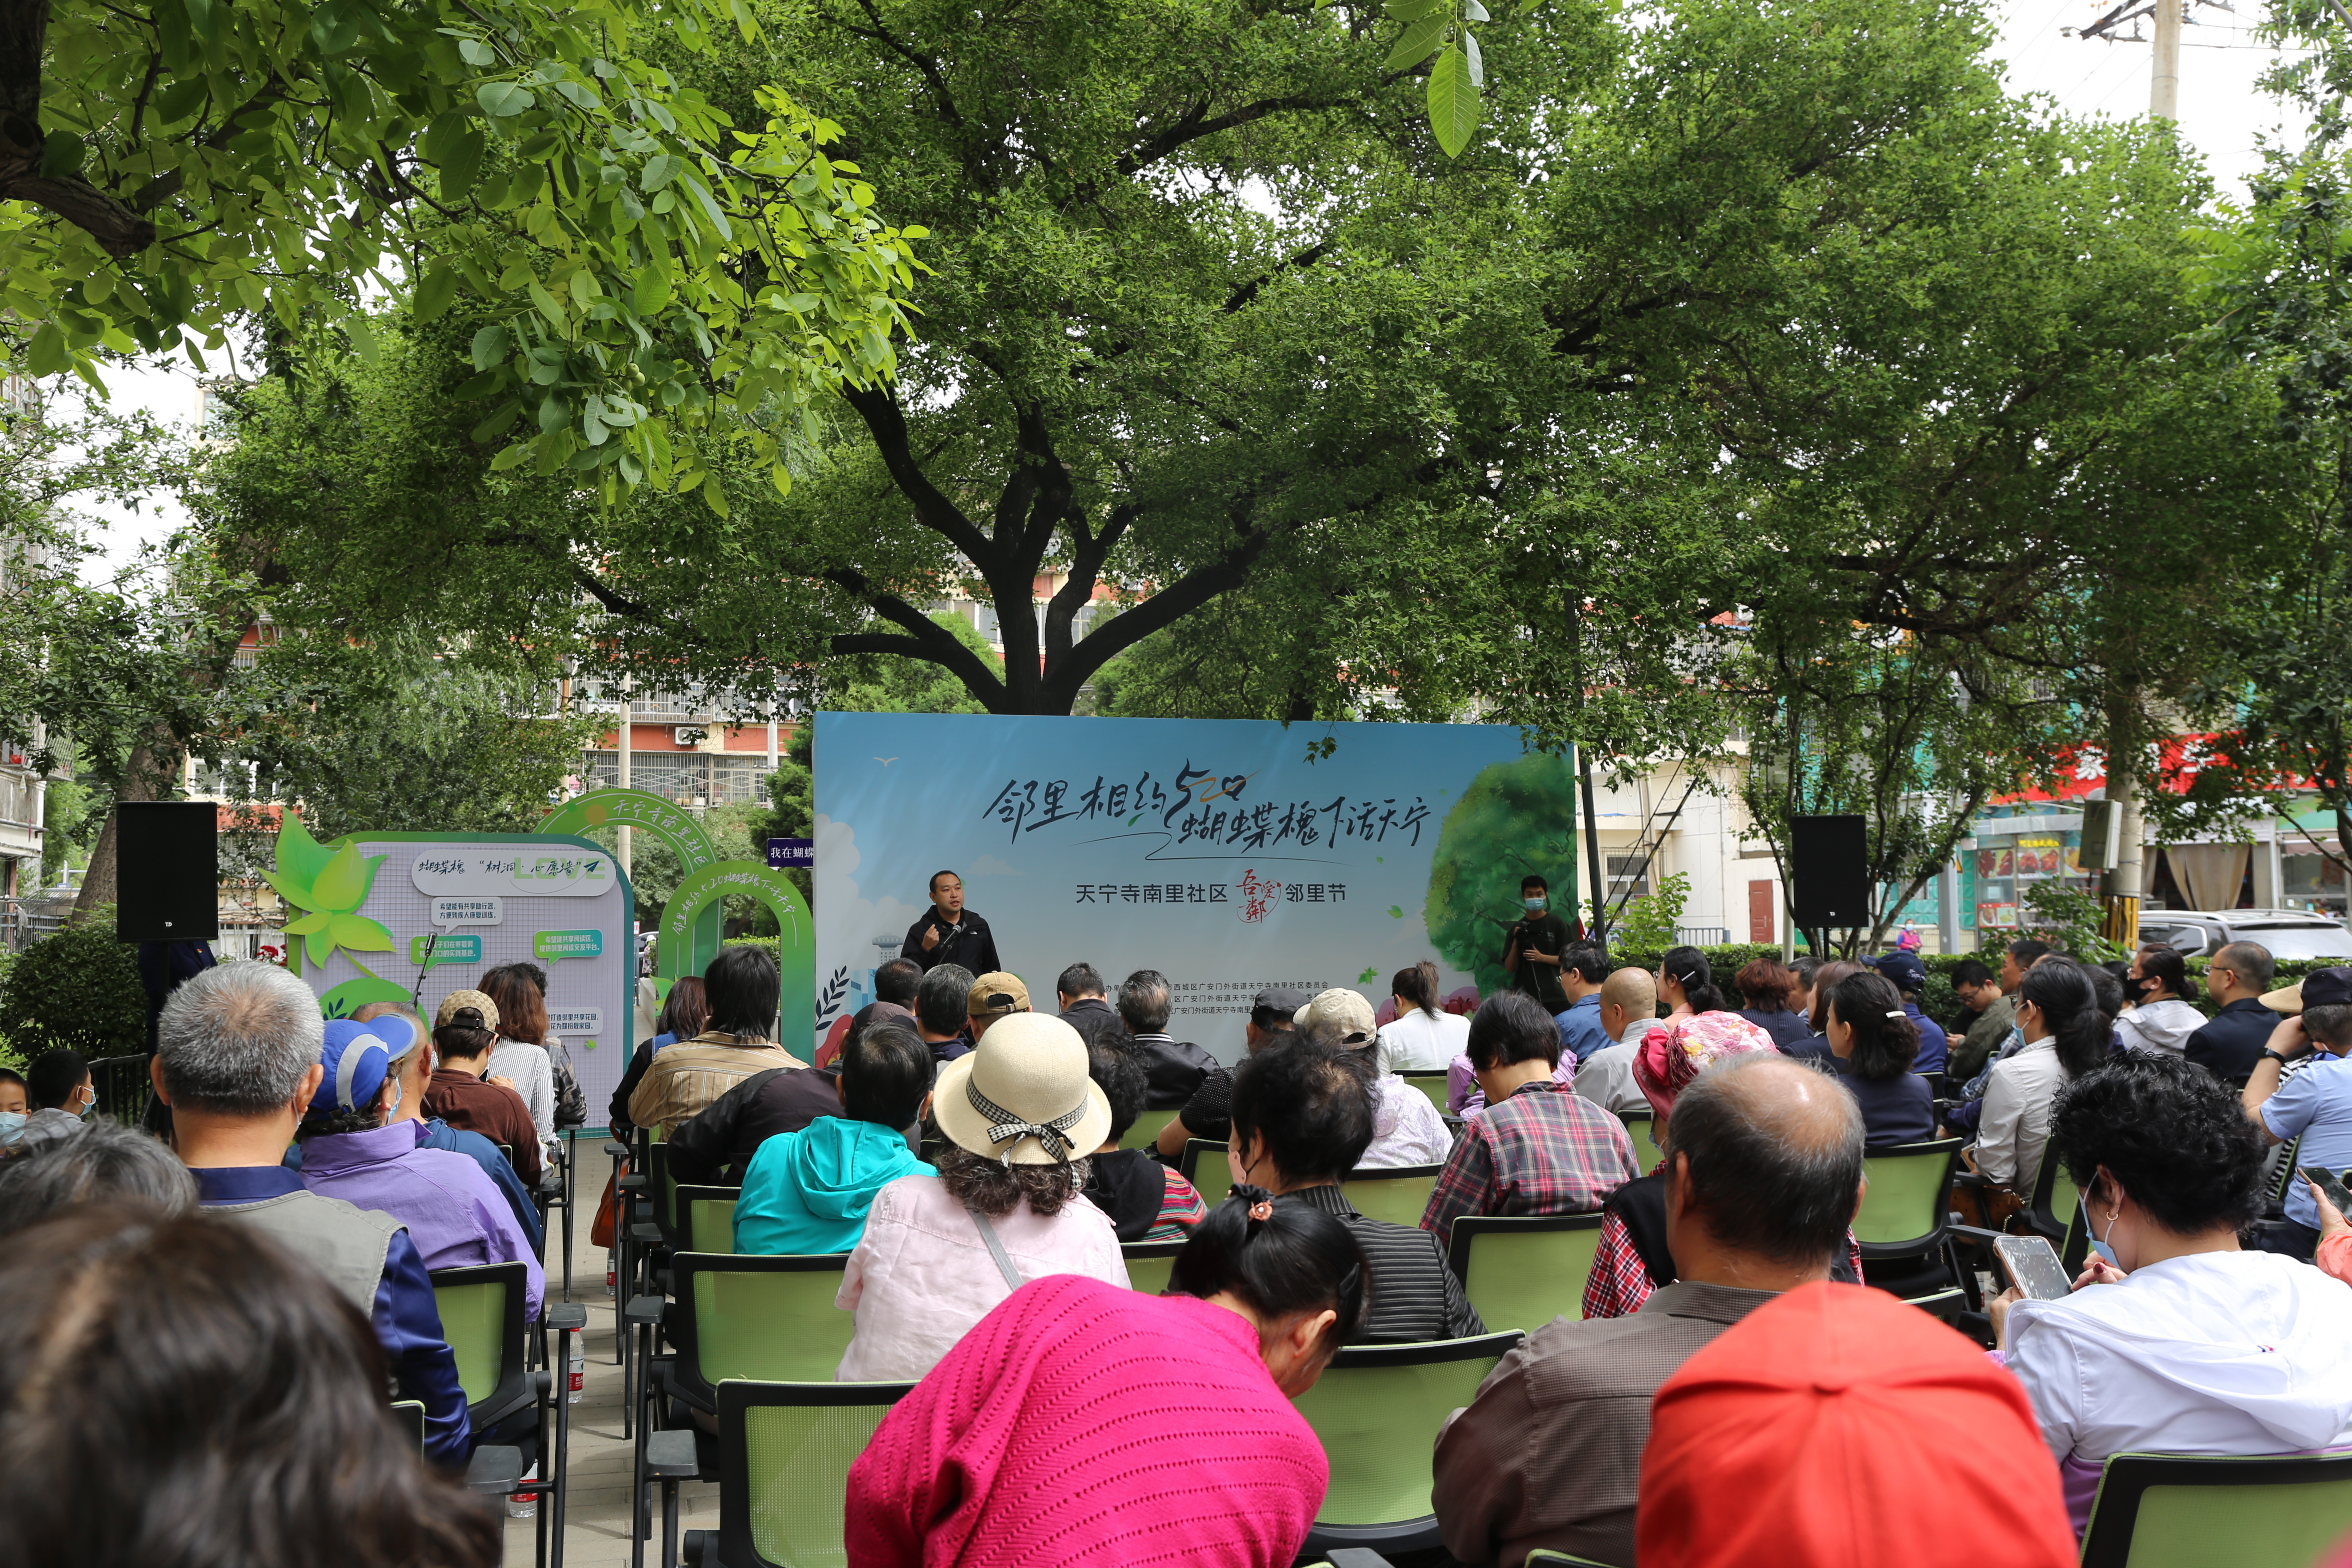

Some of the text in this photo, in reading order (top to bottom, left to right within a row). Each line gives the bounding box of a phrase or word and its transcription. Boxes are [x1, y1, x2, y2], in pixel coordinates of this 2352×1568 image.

[514, 858, 605, 879] LOVE
[1076, 883, 1228, 903] 天宁寺南里社区
[1285, 883, 1346, 902] 邻里节
[419, 949, 476, 958] 有门口的实践基地。
[1170, 1006, 1253, 1014] 广安门外街道天宁寺南里
